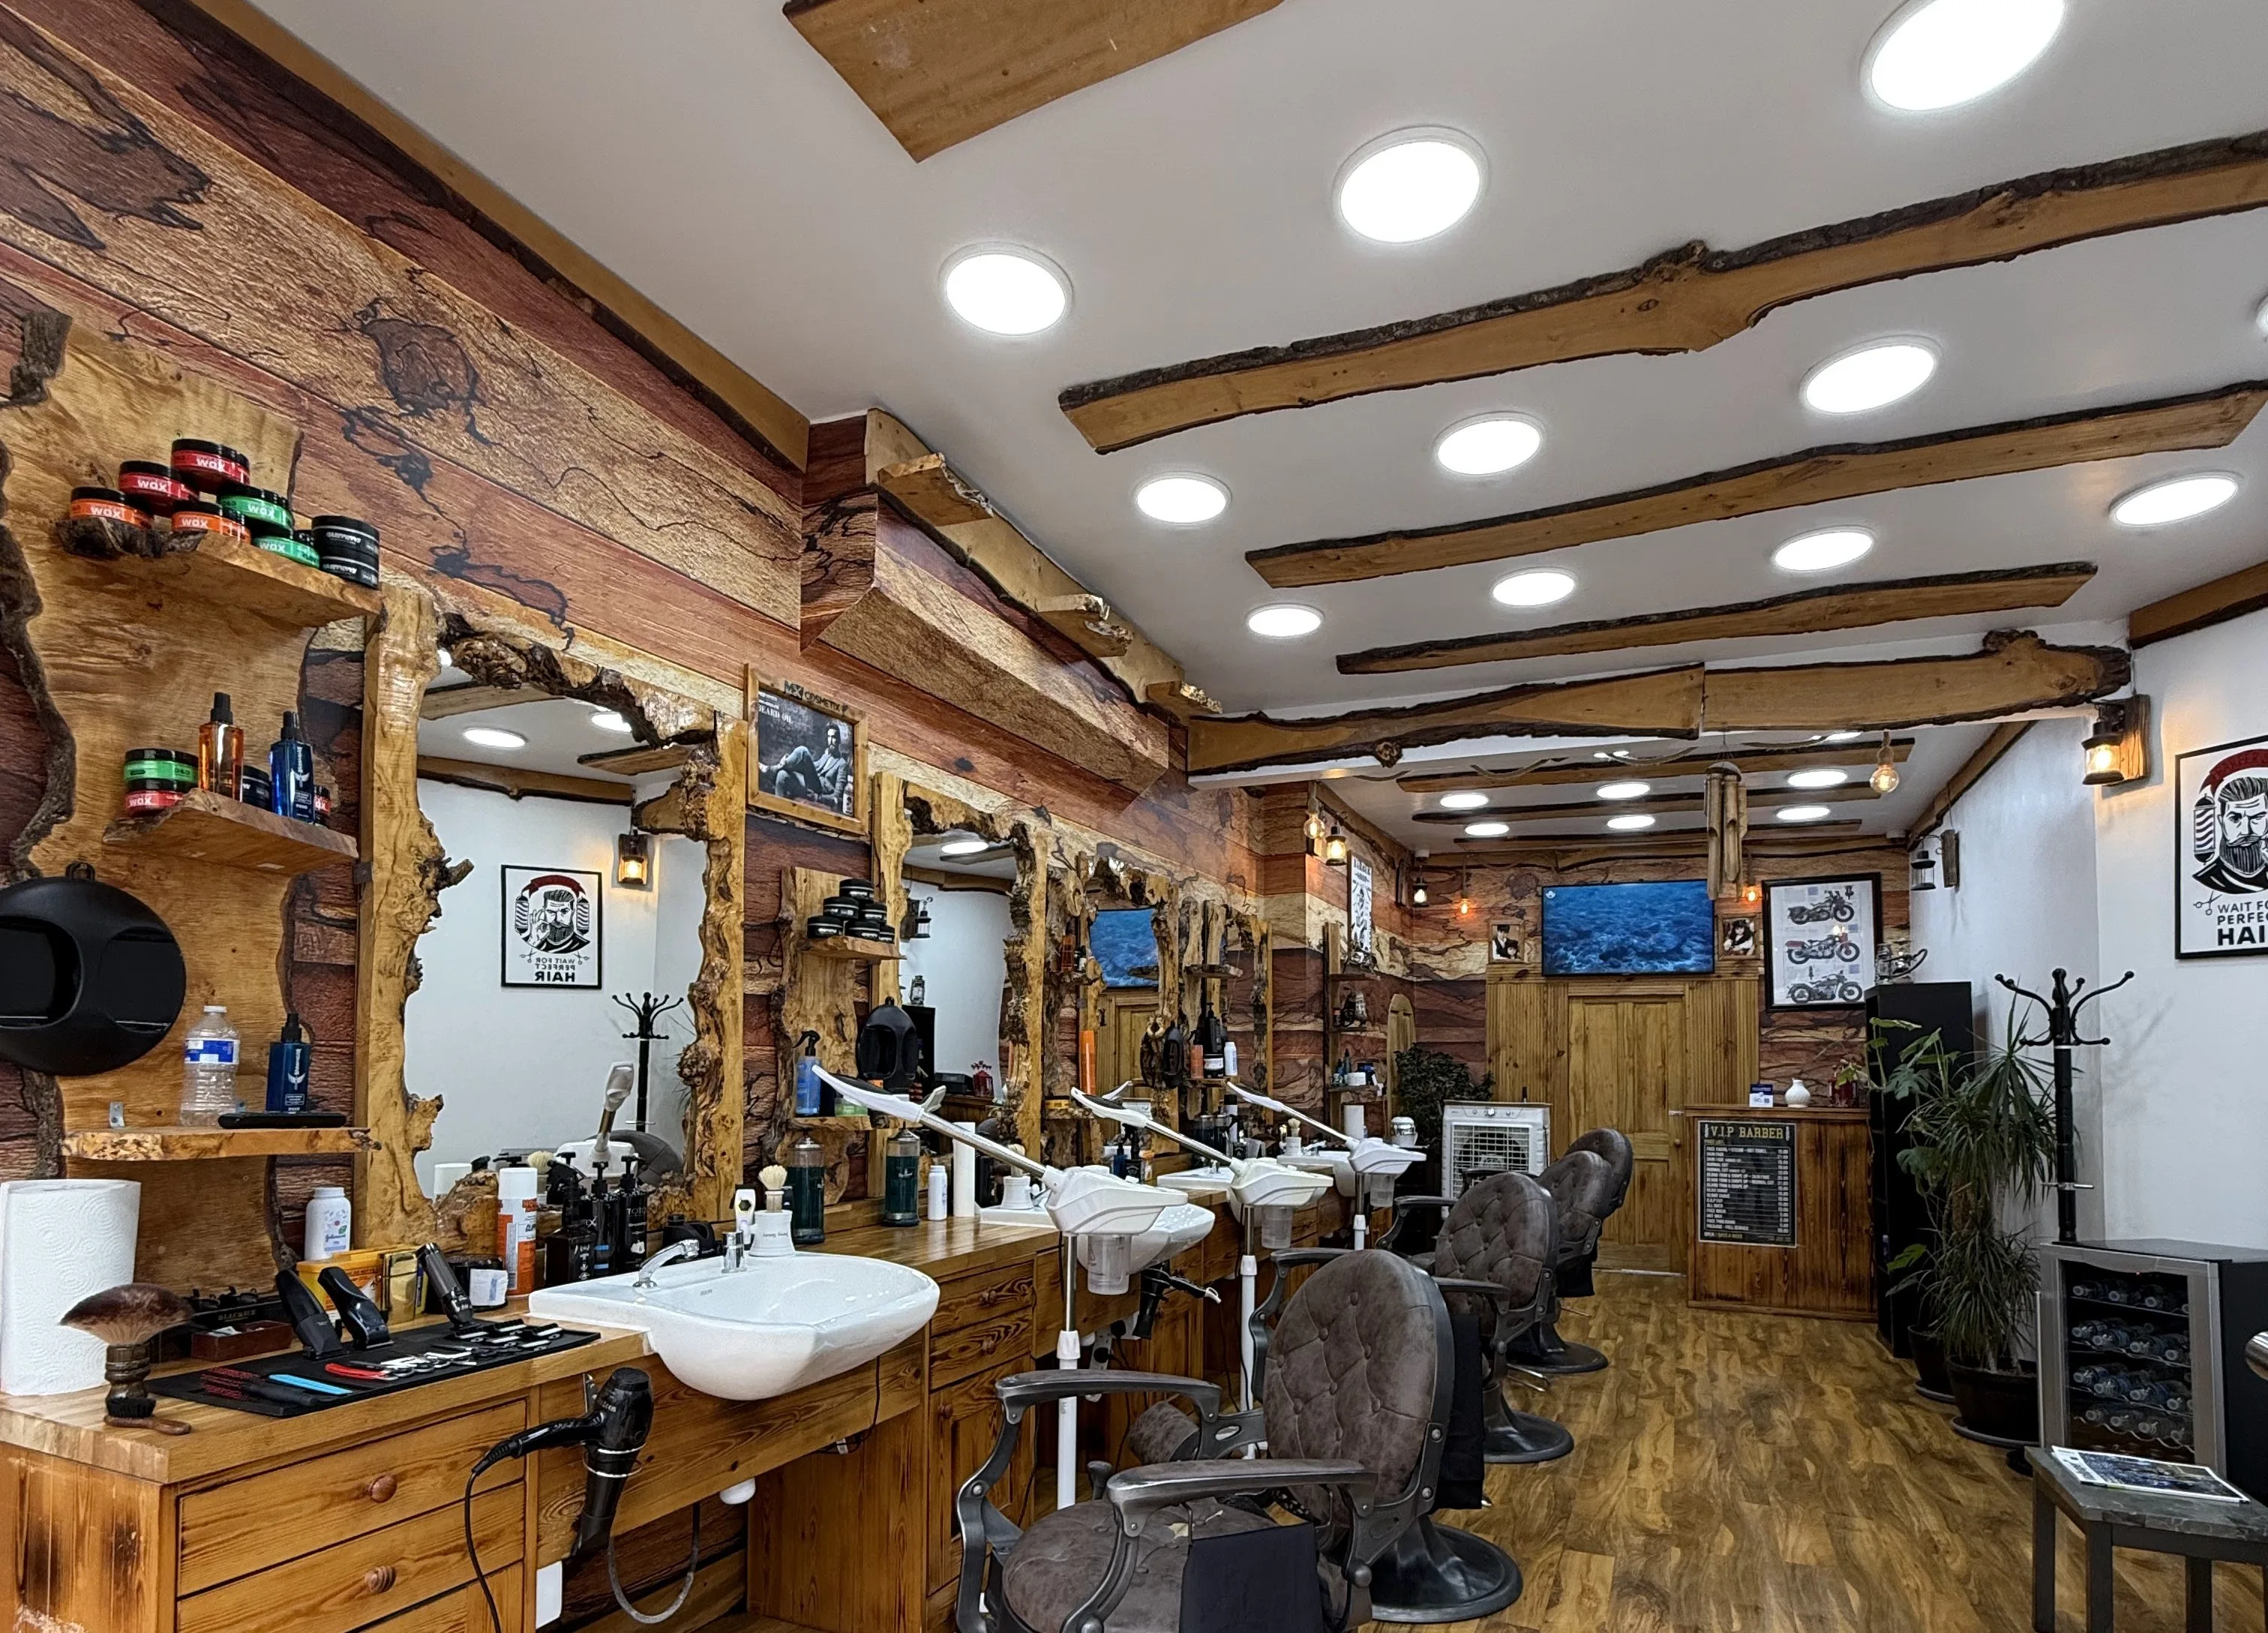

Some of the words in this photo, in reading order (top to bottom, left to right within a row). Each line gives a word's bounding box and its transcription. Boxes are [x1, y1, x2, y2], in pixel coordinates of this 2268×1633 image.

[196, 455, 225, 472] wax
[137, 479, 168, 492] wax
[90, 506, 122, 519] wax
[248, 504, 276, 519] wax
[182, 518, 208, 529] wax
[259, 542, 286, 553] wax
[129, 796, 152, 807] wax
[314, 798, 326, 811] ax
[2217, 902, 2252, 914] WAIT
[2217, 911, 2268, 926] PERFE
[1738, 1127, 1784, 1139] BARBER
